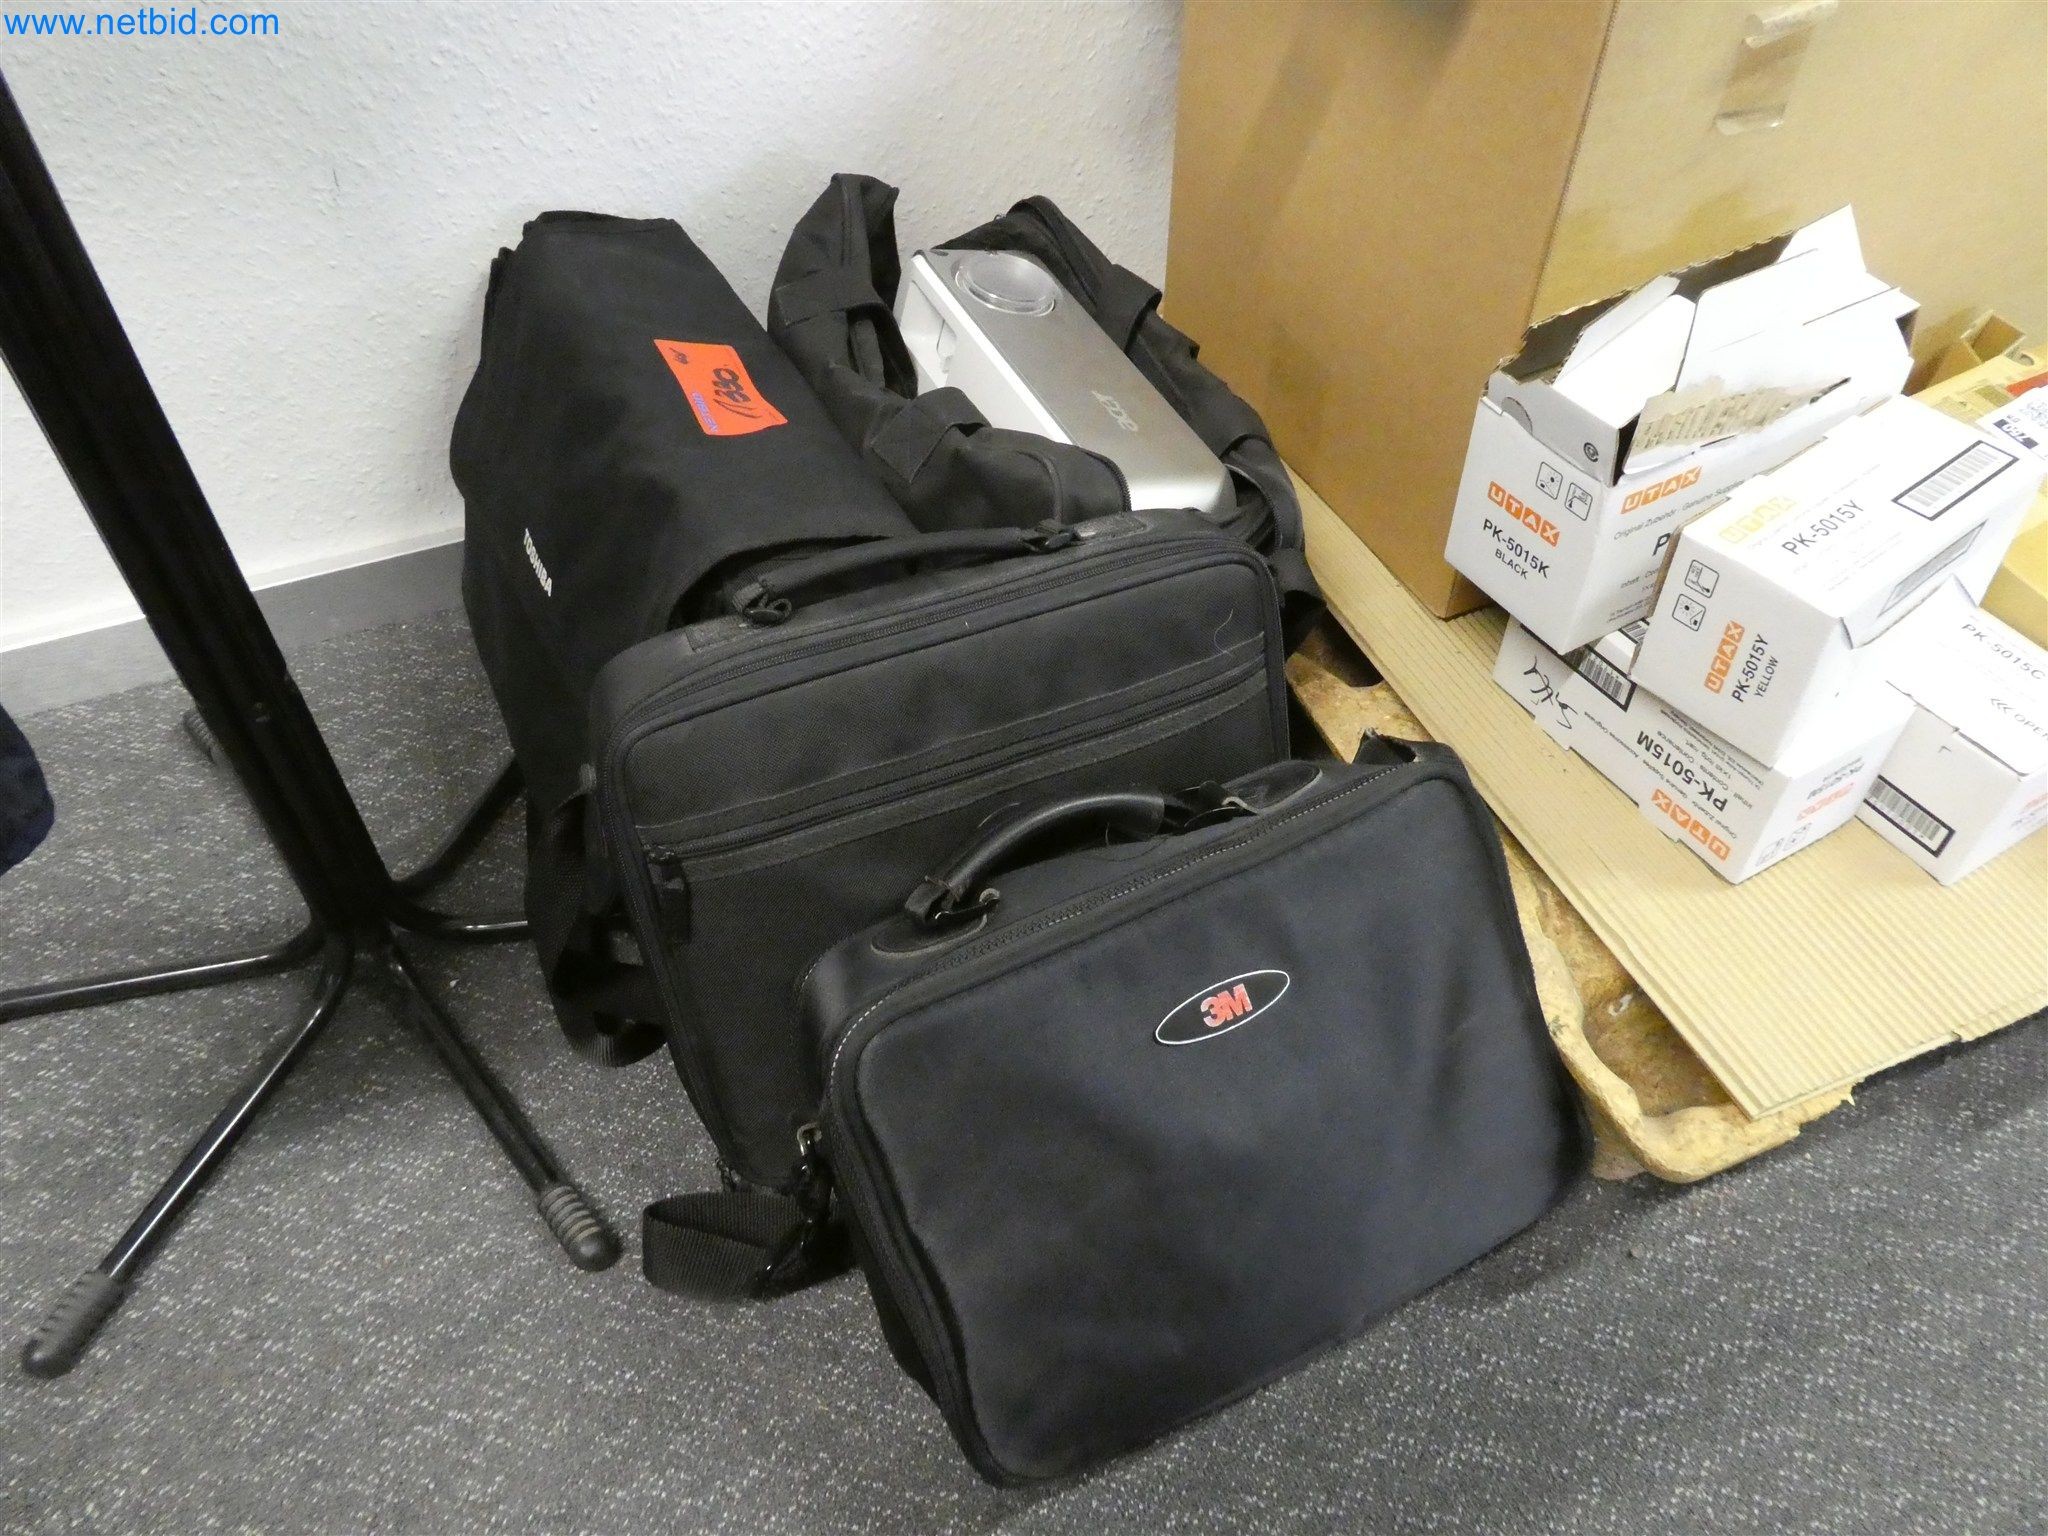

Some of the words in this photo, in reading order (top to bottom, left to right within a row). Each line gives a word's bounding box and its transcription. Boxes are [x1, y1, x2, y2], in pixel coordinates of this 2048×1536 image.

[1091, 391, 1138, 431] acer
[1487, 480, 1560, 548] UTAX
[1621, 465, 1703, 514] UTAX
[1483, 518, 1550, 579] PK-5015K
[1782, 500, 1864, 555] PK-5015Y
[523, 527, 552, 597] TOSHIBA
[1494, 548, 1528, 580] BLACK
[1703, 620, 1745, 694] UTAX
[1731, 633, 1769, 703] PK-5015Y
[1754, 655, 1778, 698] YELLOW
[1634, 730, 1728, 811] PK-5015M
[1649, 788, 1731, 861] UTAX
[1200, 983, 1253, 1028] 3M
